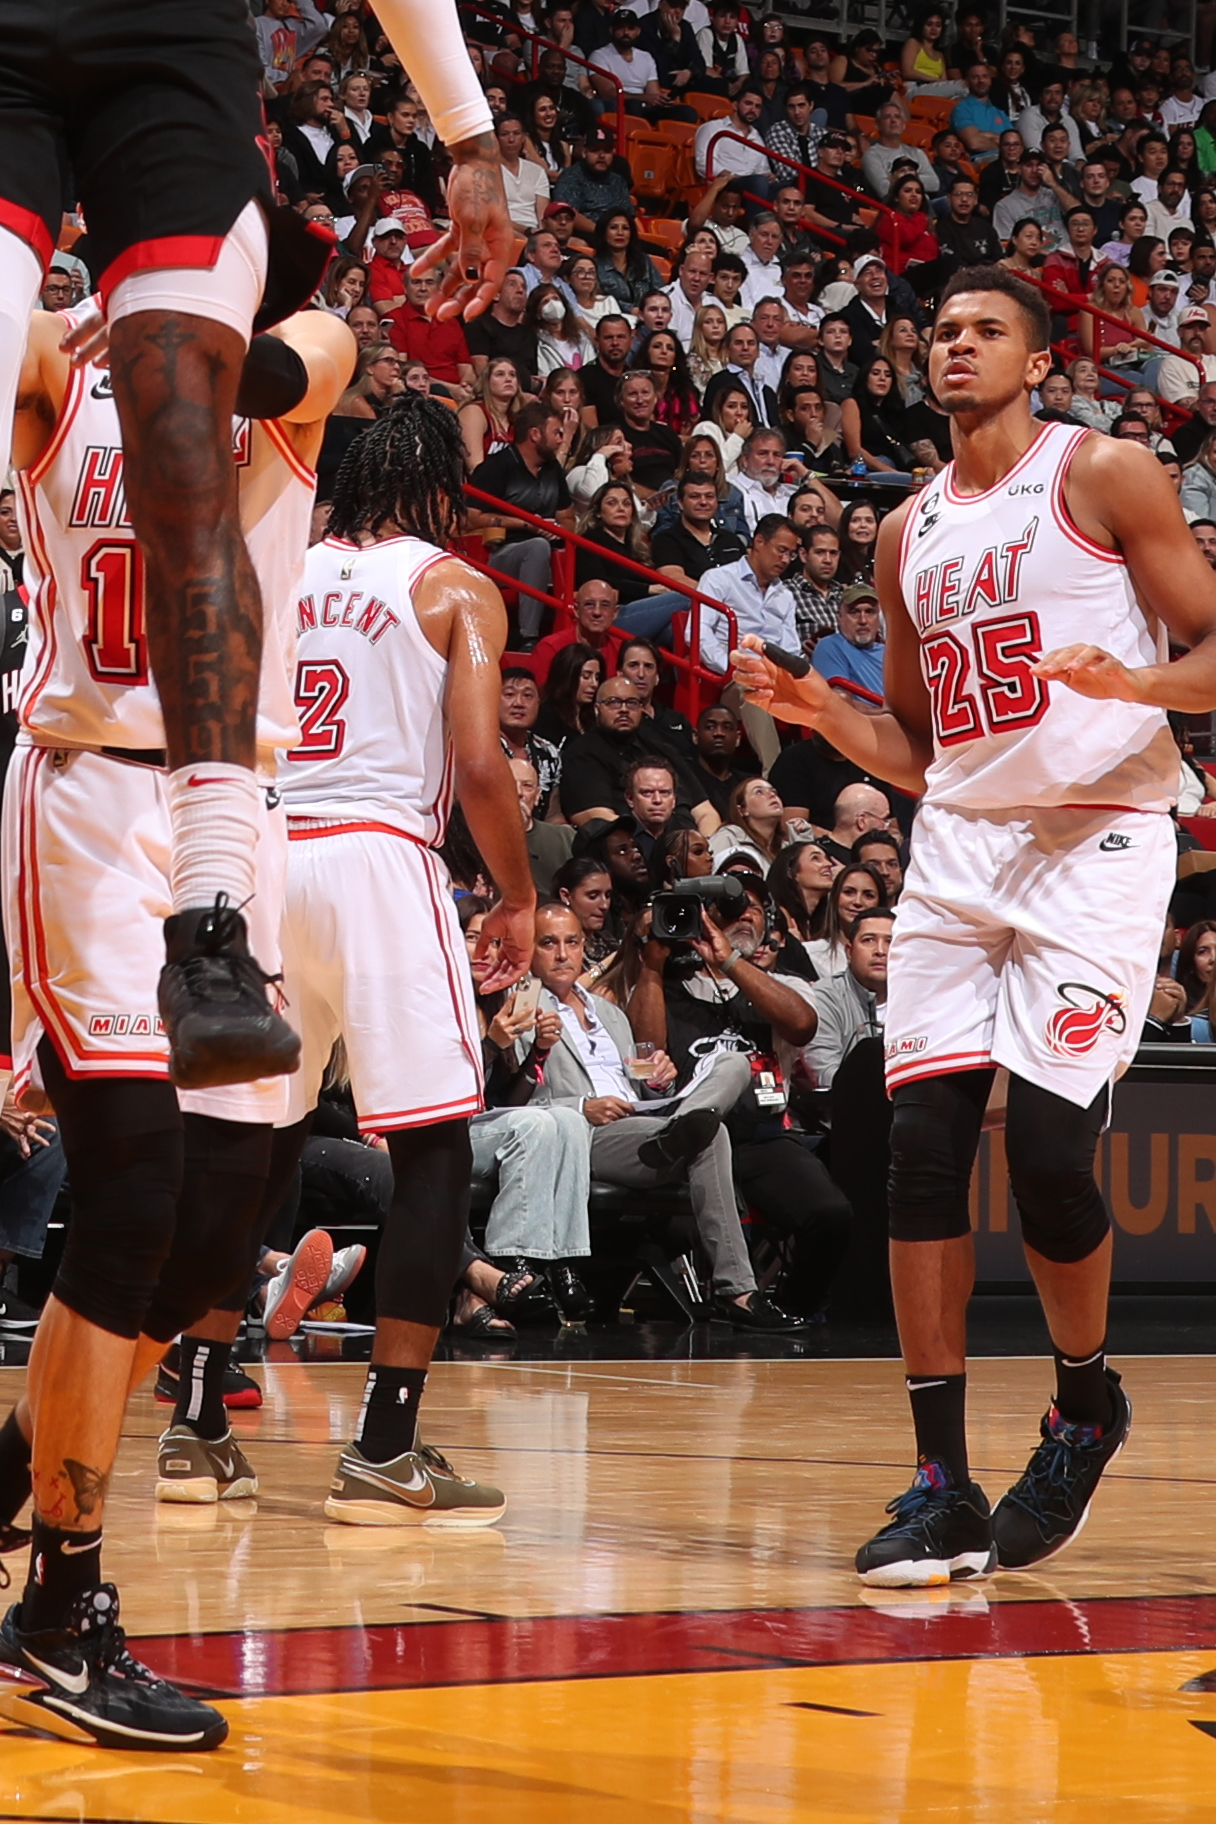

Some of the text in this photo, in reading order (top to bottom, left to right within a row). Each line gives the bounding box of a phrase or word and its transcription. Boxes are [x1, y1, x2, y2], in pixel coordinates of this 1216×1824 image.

[1008, 483, 1045, 497] UKG
[916, 517, 1039, 634] HEAT
[11, 608, 23, 623] 6
[295, 591, 401, 646] NCENT
[920, 612, 1050, 748] 25
[286, 659, 350, 761] 2
[1106, 832, 1132, 848] NIKE
[88, 1015, 168, 1038] MIA
[885, 1037, 928, 1060] AMI
